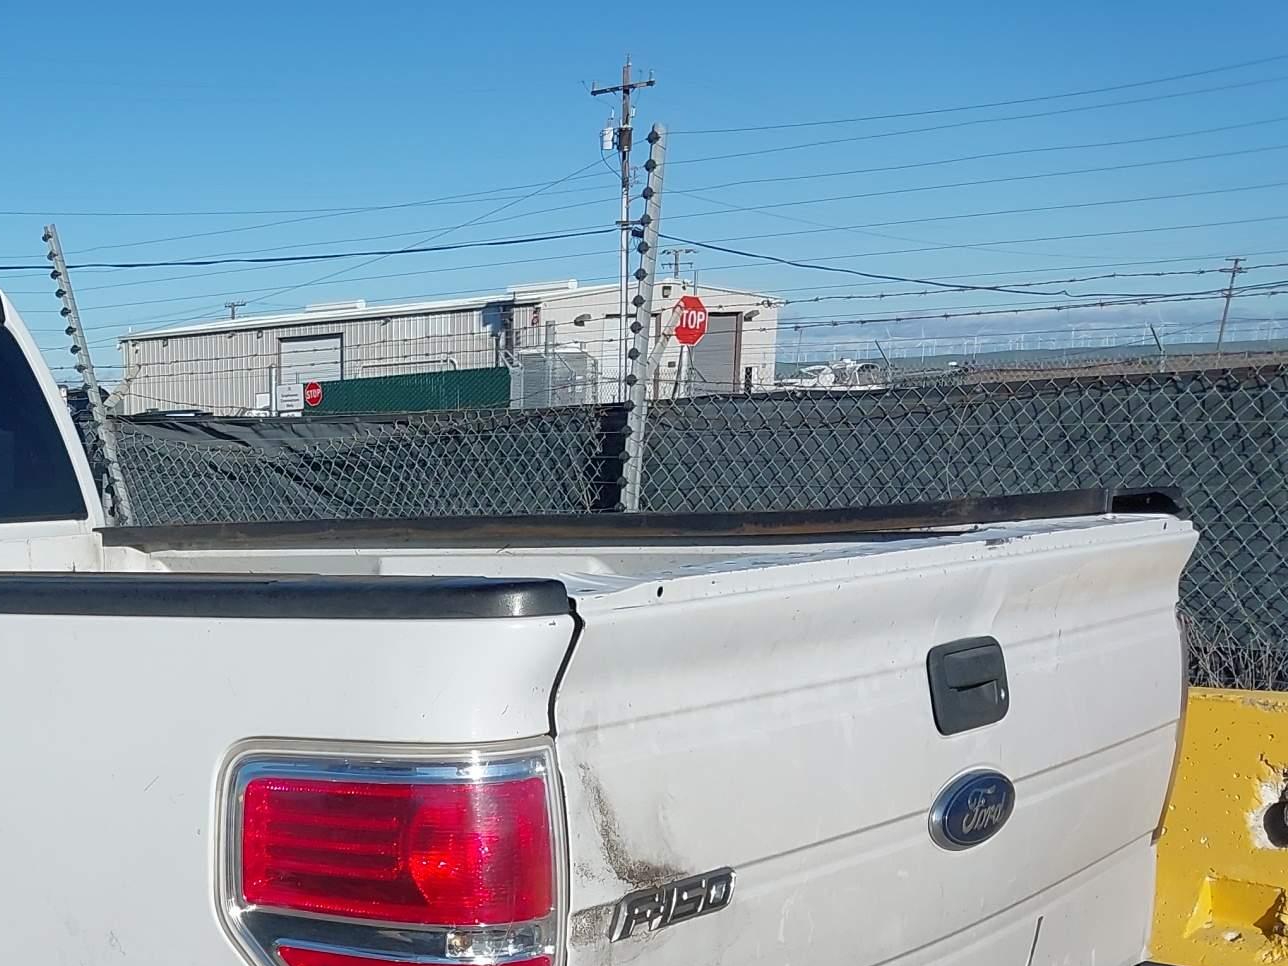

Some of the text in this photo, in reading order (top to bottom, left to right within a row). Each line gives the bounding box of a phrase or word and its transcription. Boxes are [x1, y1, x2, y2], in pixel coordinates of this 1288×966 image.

[681, 309, 706, 329] TOP
[306, 388, 321, 400] STOP
[962, 785, 1007, 834] Ford
